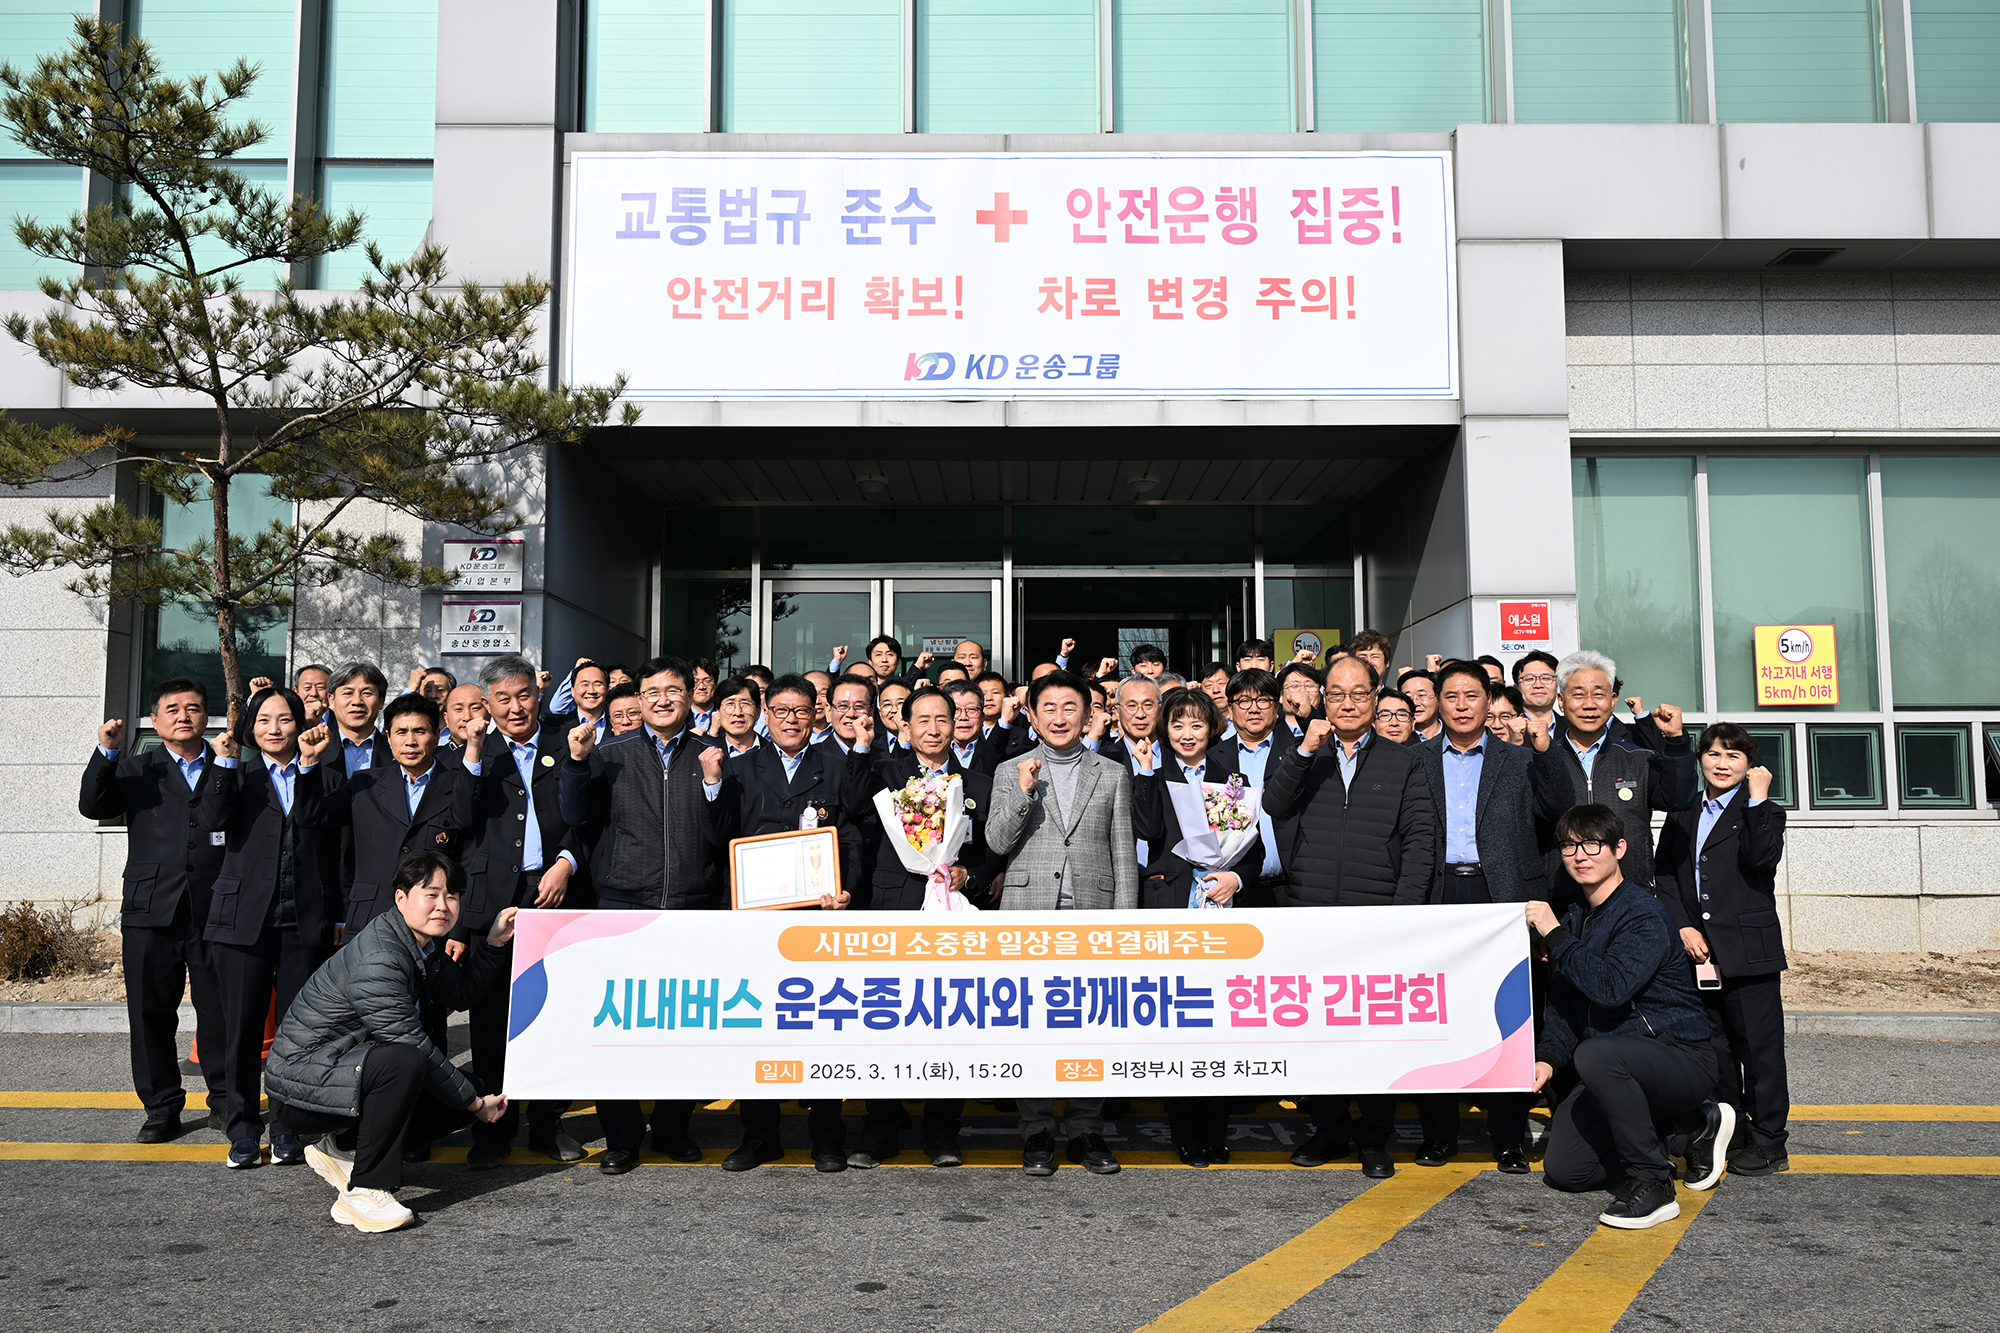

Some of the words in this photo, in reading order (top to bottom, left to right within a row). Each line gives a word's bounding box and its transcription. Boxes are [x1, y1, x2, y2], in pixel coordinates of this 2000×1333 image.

[616, 187, 811, 246] 교통법규
[841, 187, 935, 245] 준수
[1066, 186, 1257, 245] 안전운행
[1290, 186, 1401, 245] 집중!
[667, 277, 835, 320] 안전거리
[864, 275, 963, 320] 확보!
[1037, 276, 1120, 319] 차로
[1148, 276, 1228, 320] 변경
[1256, 275, 1355, 320] 주의!
[965, 354, 1008, 380] KD
[1015, 354, 1120, 379] 운송그룹
[1508, 613, 1540, 626] 에스원
[1761, 665, 1807, 680] 차고지내
[1810, 665, 1833, 680] 서행
[1764, 684, 1806, 700] 5km/h
[1809, 684, 1833, 699] 이하
[814, 932, 896, 956] 시민의
[905, 931, 989, 956] 소중한
[997, 931, 1079, 955] 일상을
[1088, 930, 1227, 954] 연결해주는
[593, 978, 762, 1030] 시내버스
[775, 977, 1033, 1031] 운수종사자와
[1044, 976, 1214, 1028] 함께하는
[1226, 975, 1312, 1027] 현장
[1323, 973, 1447, 1026] 간담회
[761, 1063, 798, 1081] 일시
[810, 1064, 861, 1080] 2025.
[869, 1064, 885, 1080] 3.
[968, 1063, 1022, 1078] 15:20
[1063, 1062, 1099, 1079] 장소
[1111, 1061, 1183, 1079] 의정부시
[1190, 1060, 1225, 1078] 공영
[1234, 1060, 1287, 1077] 차고지
